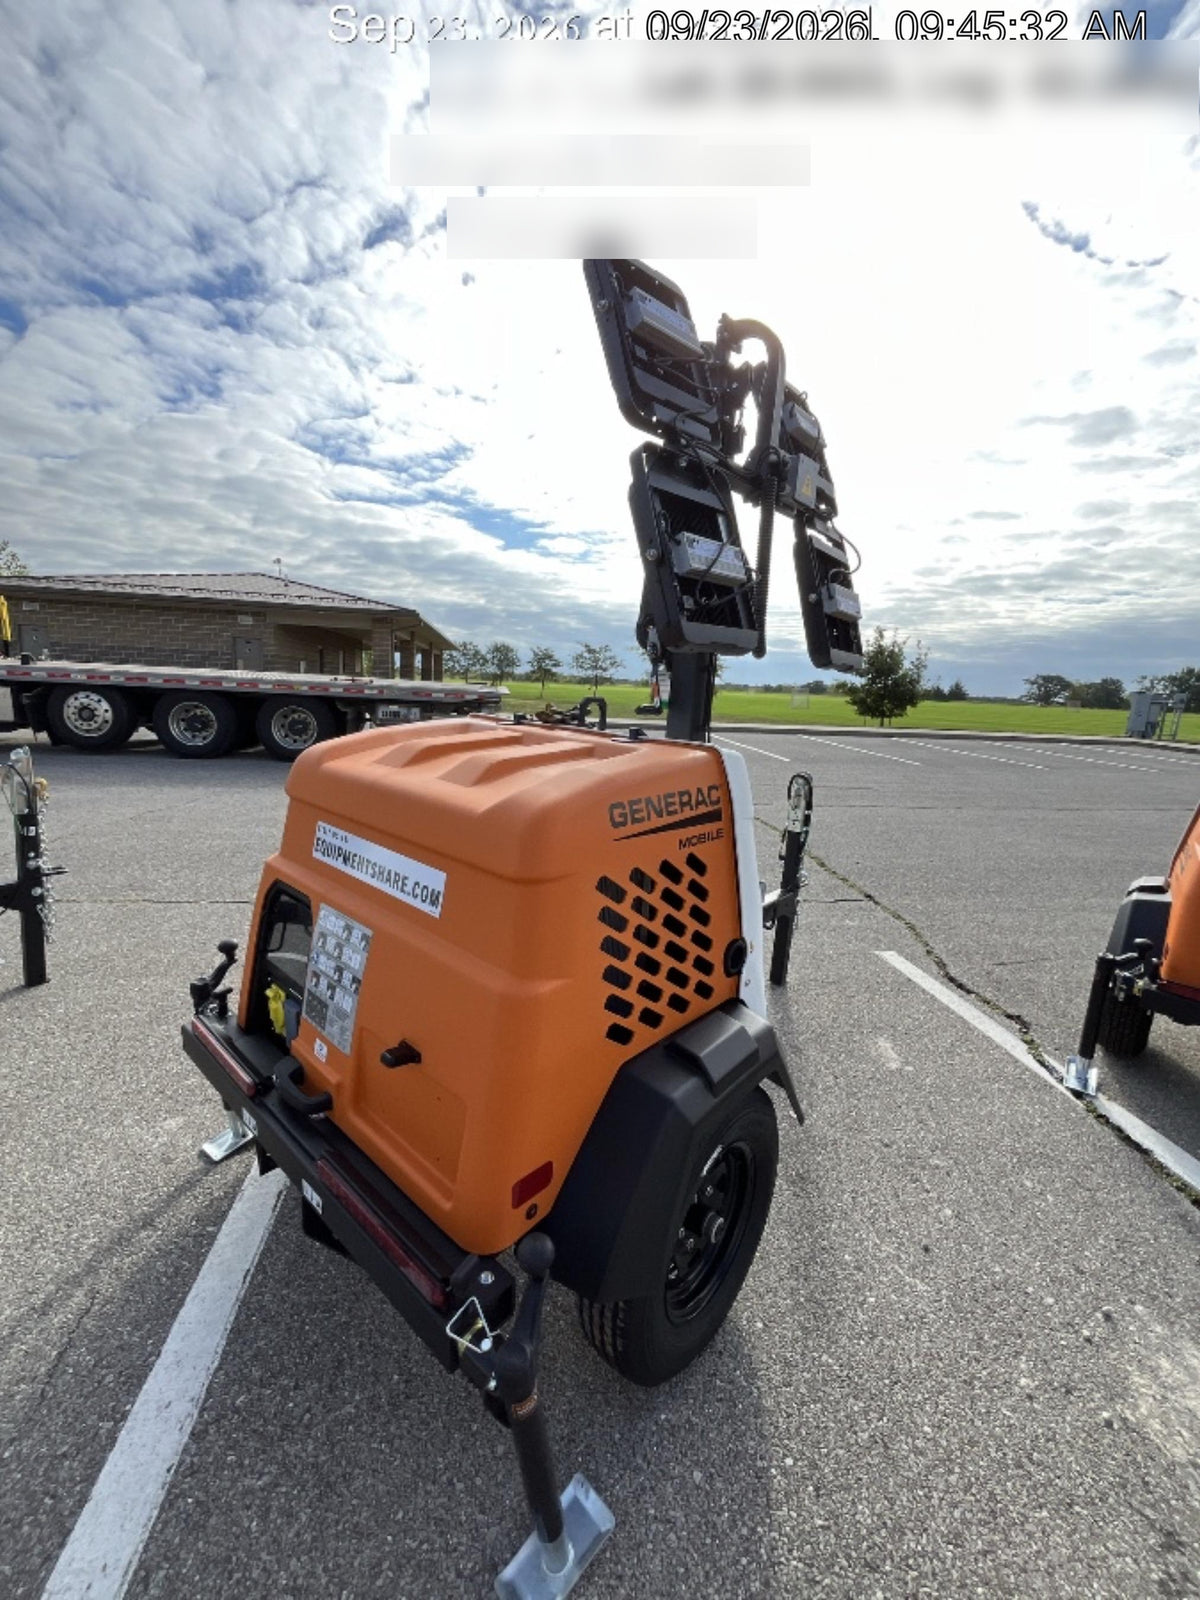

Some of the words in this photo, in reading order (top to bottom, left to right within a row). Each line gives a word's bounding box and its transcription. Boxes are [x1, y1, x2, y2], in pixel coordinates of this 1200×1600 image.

[609, 785, 721, 829] GENERAC
[678, 828, 725, 850] MOBILE
[313, 837, 442, 910] EQUIPMENTSHARE.COM
